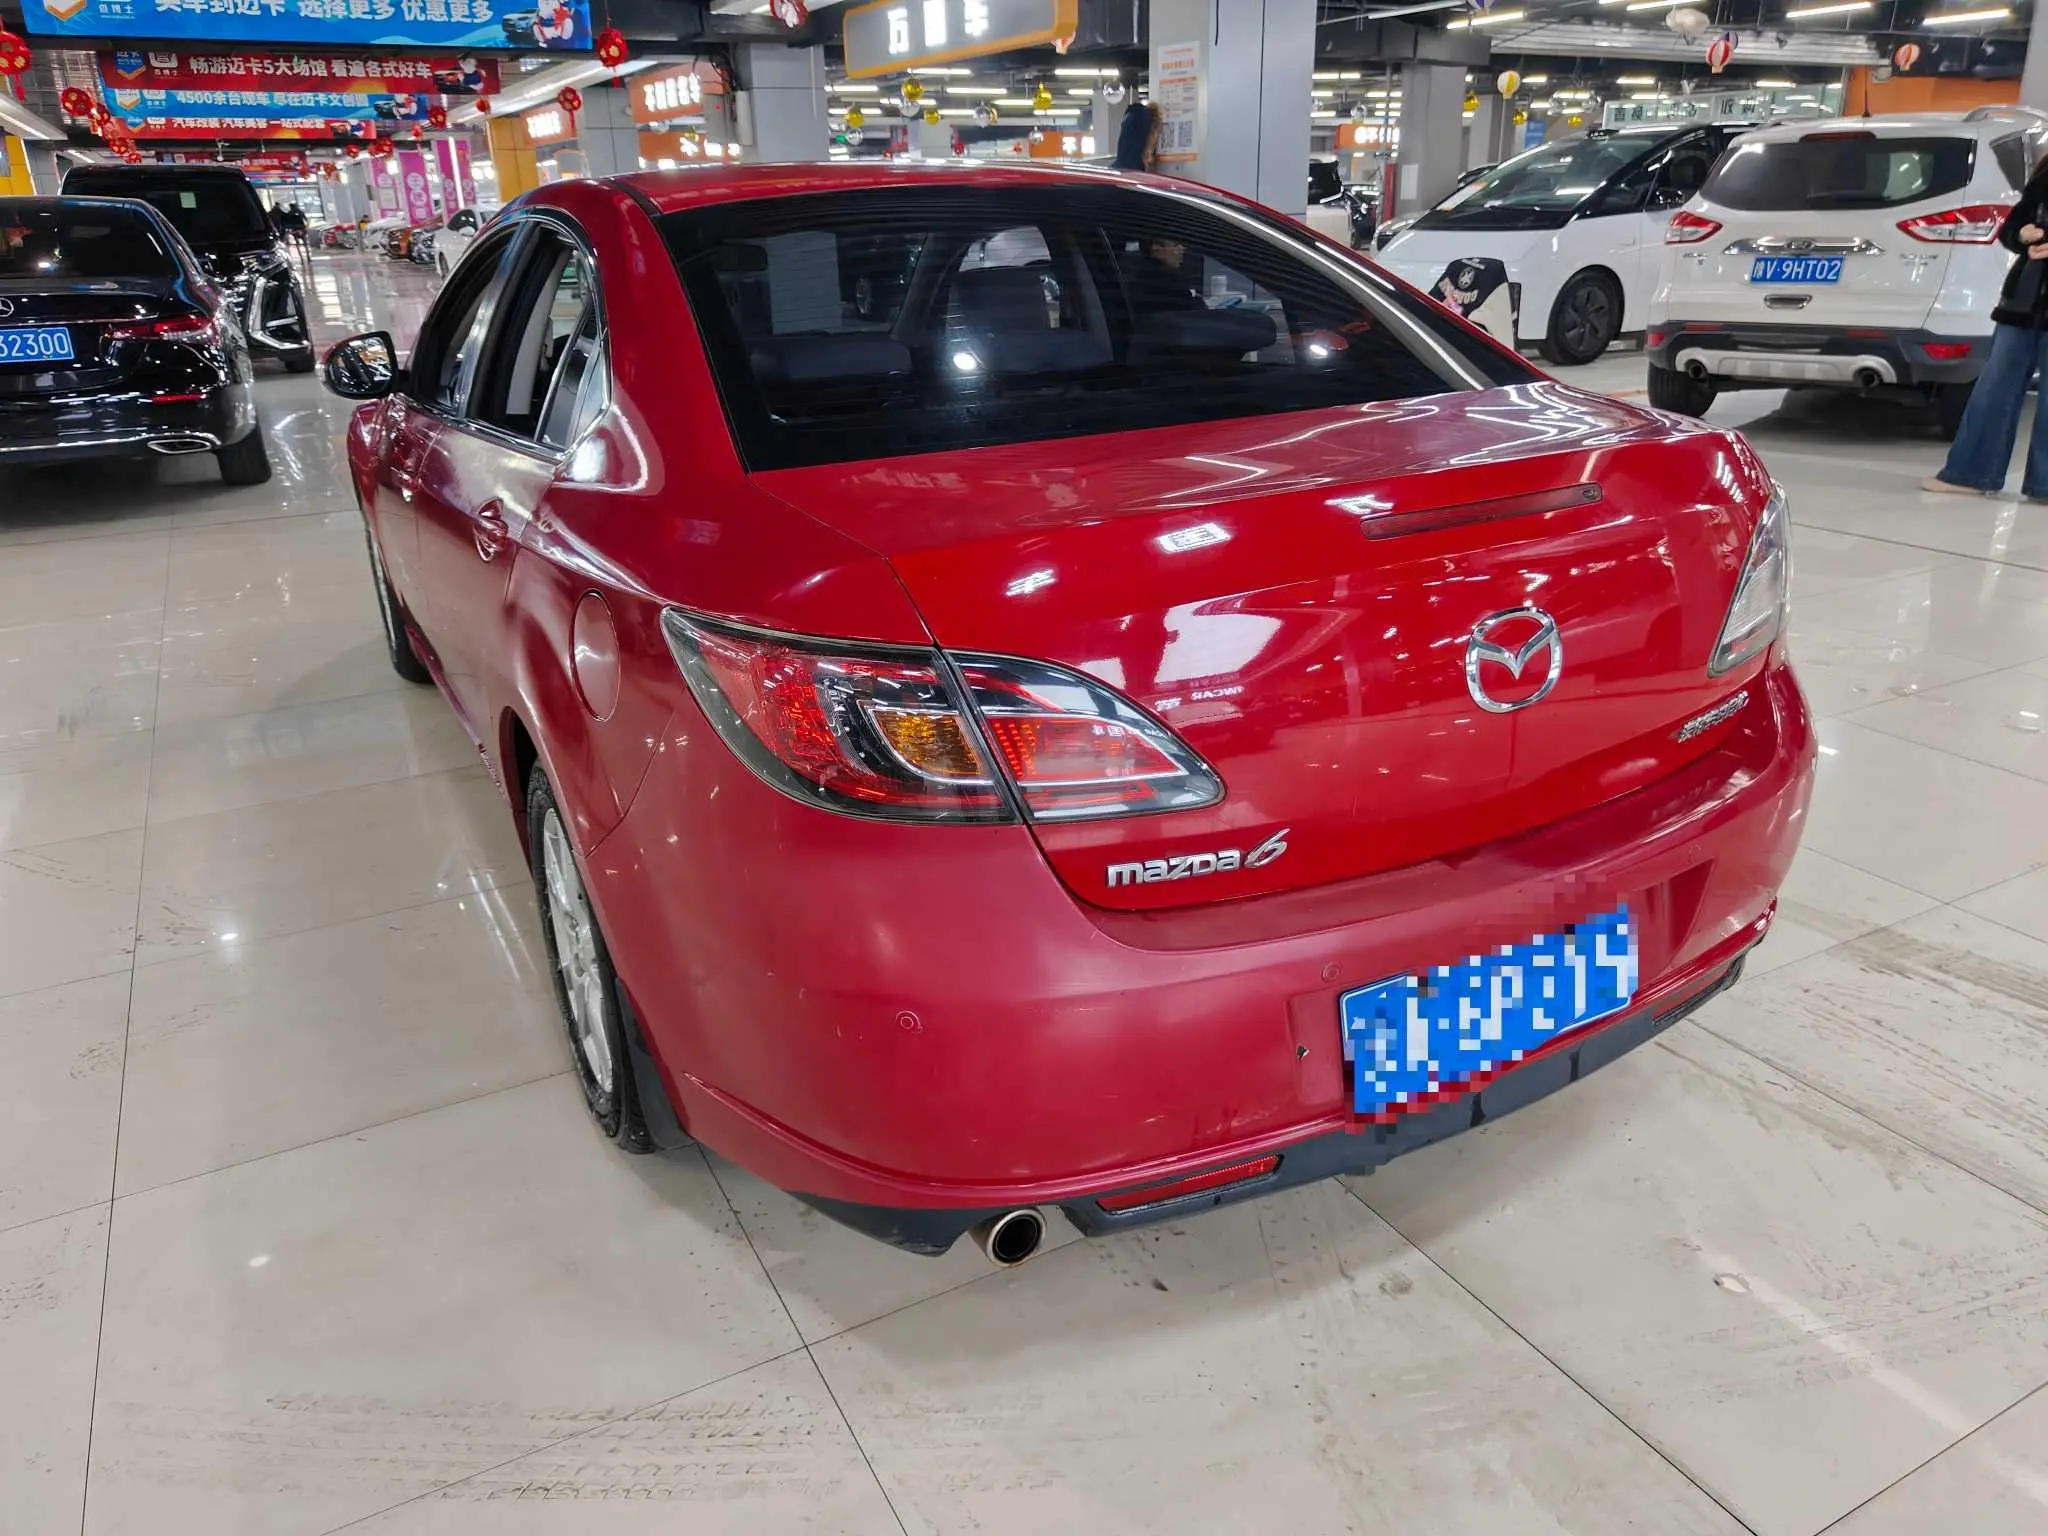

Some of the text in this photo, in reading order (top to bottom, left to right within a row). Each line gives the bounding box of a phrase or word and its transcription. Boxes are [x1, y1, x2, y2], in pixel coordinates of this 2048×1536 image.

[299, 0, 396, 20] 选择更多
[401, 0, 494, 24] 优惠更多
[189, 56, 327, 78] 畅游迈卡5大场馆
[331, 58, 433, 79] 看遍各式好车
[1244, 828, 1291, 869] 6
